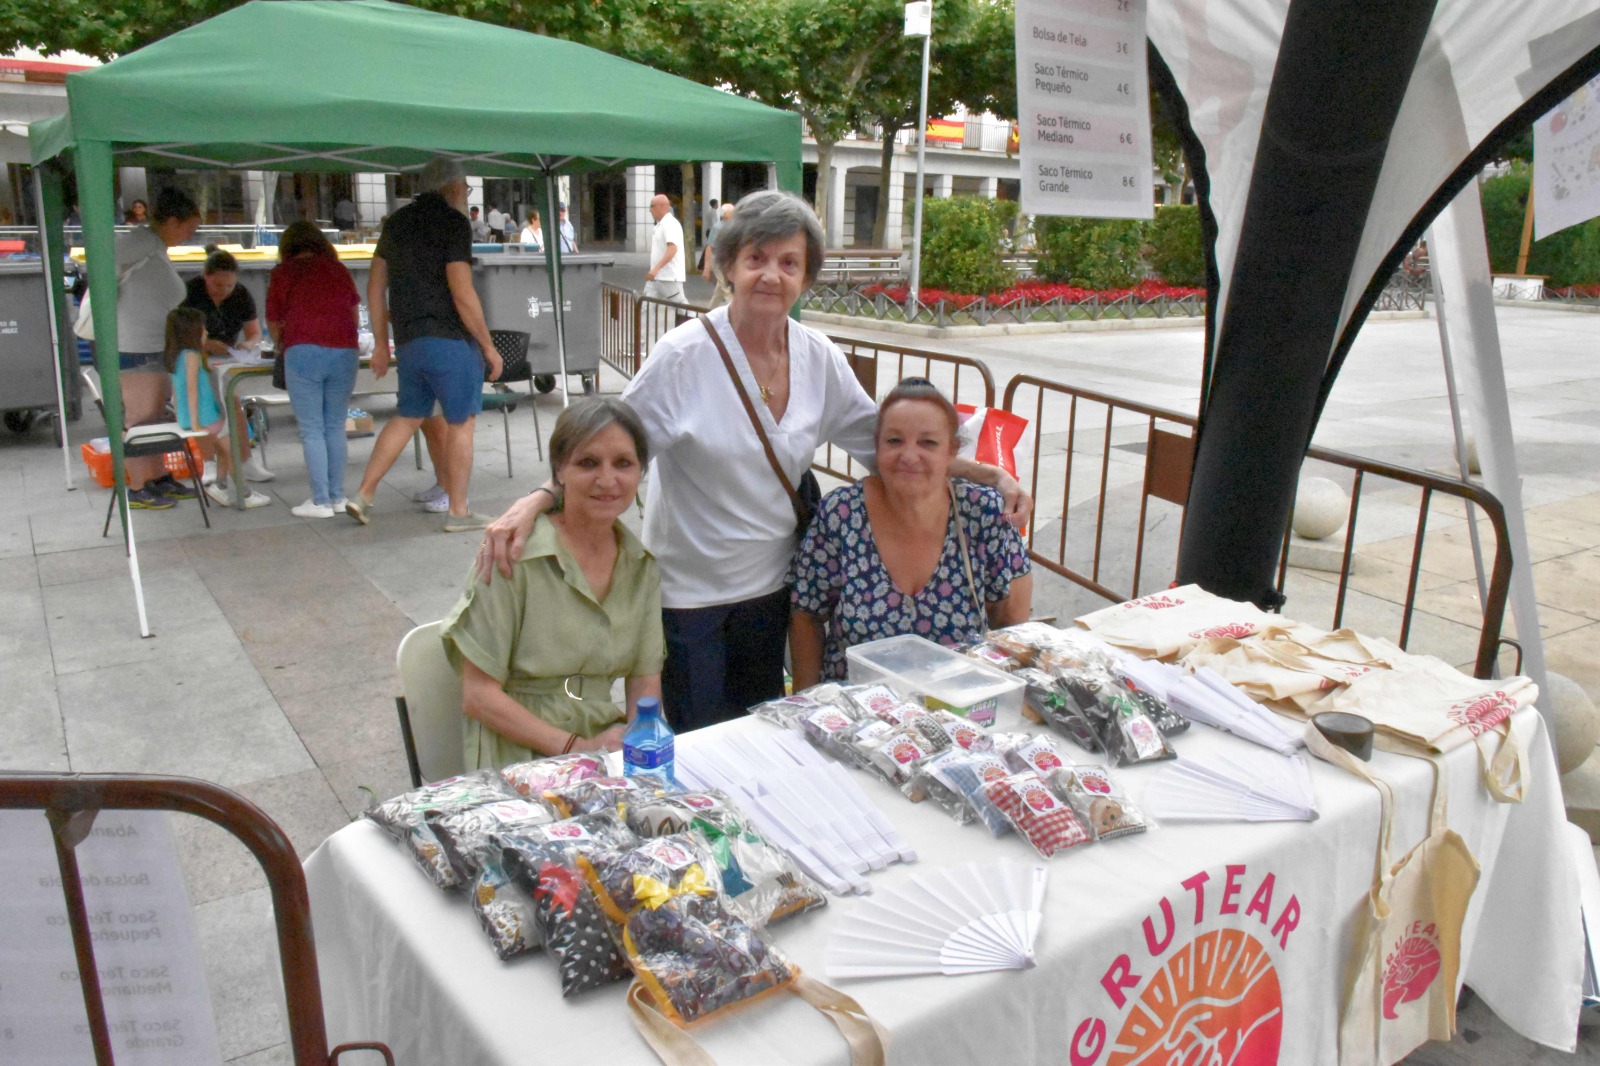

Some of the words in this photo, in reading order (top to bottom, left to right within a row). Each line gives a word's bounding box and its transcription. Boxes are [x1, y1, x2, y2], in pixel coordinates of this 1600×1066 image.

[1033, 26, 1056, 41] Bolsa
[1057, 31, 1067, 44] de
[1068, 33, 1087, 47] Tela
[1034, 62, 1054, 76] Saco
[1056, 65, 1089, 81] Térmico
[1035, 78, 1072, 94] Pequeño
[1037, 114, 1057, 127] Saco
[1058, 116, 1091, 131] Térmico
[1037, 129, 1074, 144] Mediano
[1038, 164, 1058, 177] Saco
[1060, 166, 1093, 179] Térmico
[1039, 180, 1070, 193] Grande
[1069, 864, 1301, 1066] GRUTEAR
